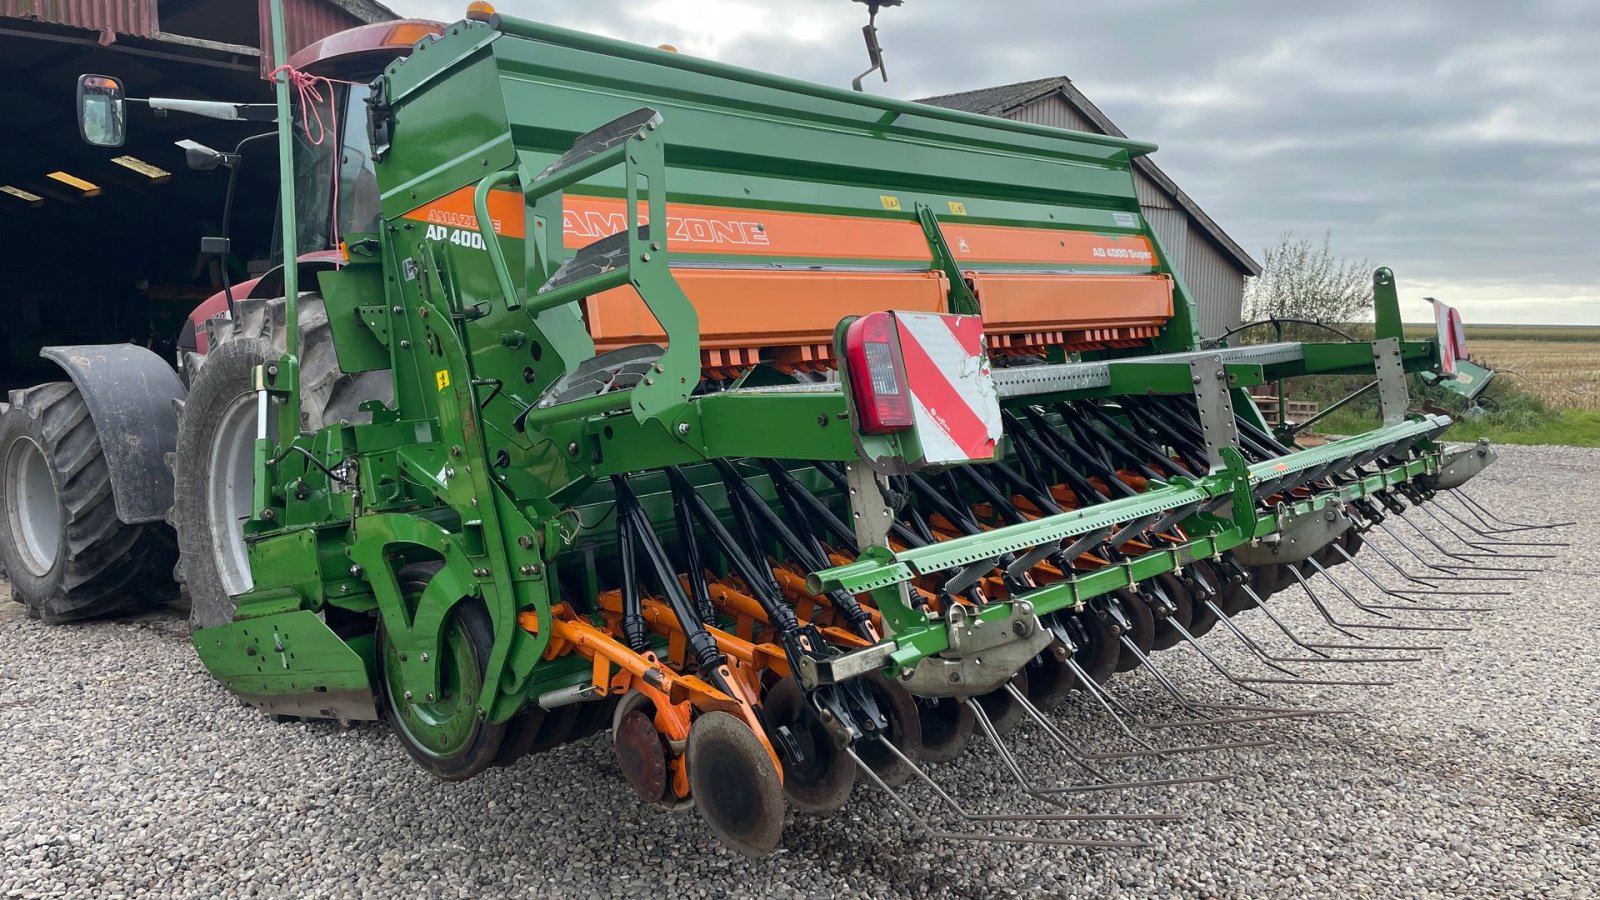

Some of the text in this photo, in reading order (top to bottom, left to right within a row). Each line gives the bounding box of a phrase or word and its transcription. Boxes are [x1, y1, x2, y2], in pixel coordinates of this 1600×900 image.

[427, 209, 502, 234] AMAZOE
[562, 210, 770, 246] AMZONE
[425, 224, 448, 241] AD
[1092, 247, 1153, 261] AD 4000 Super
